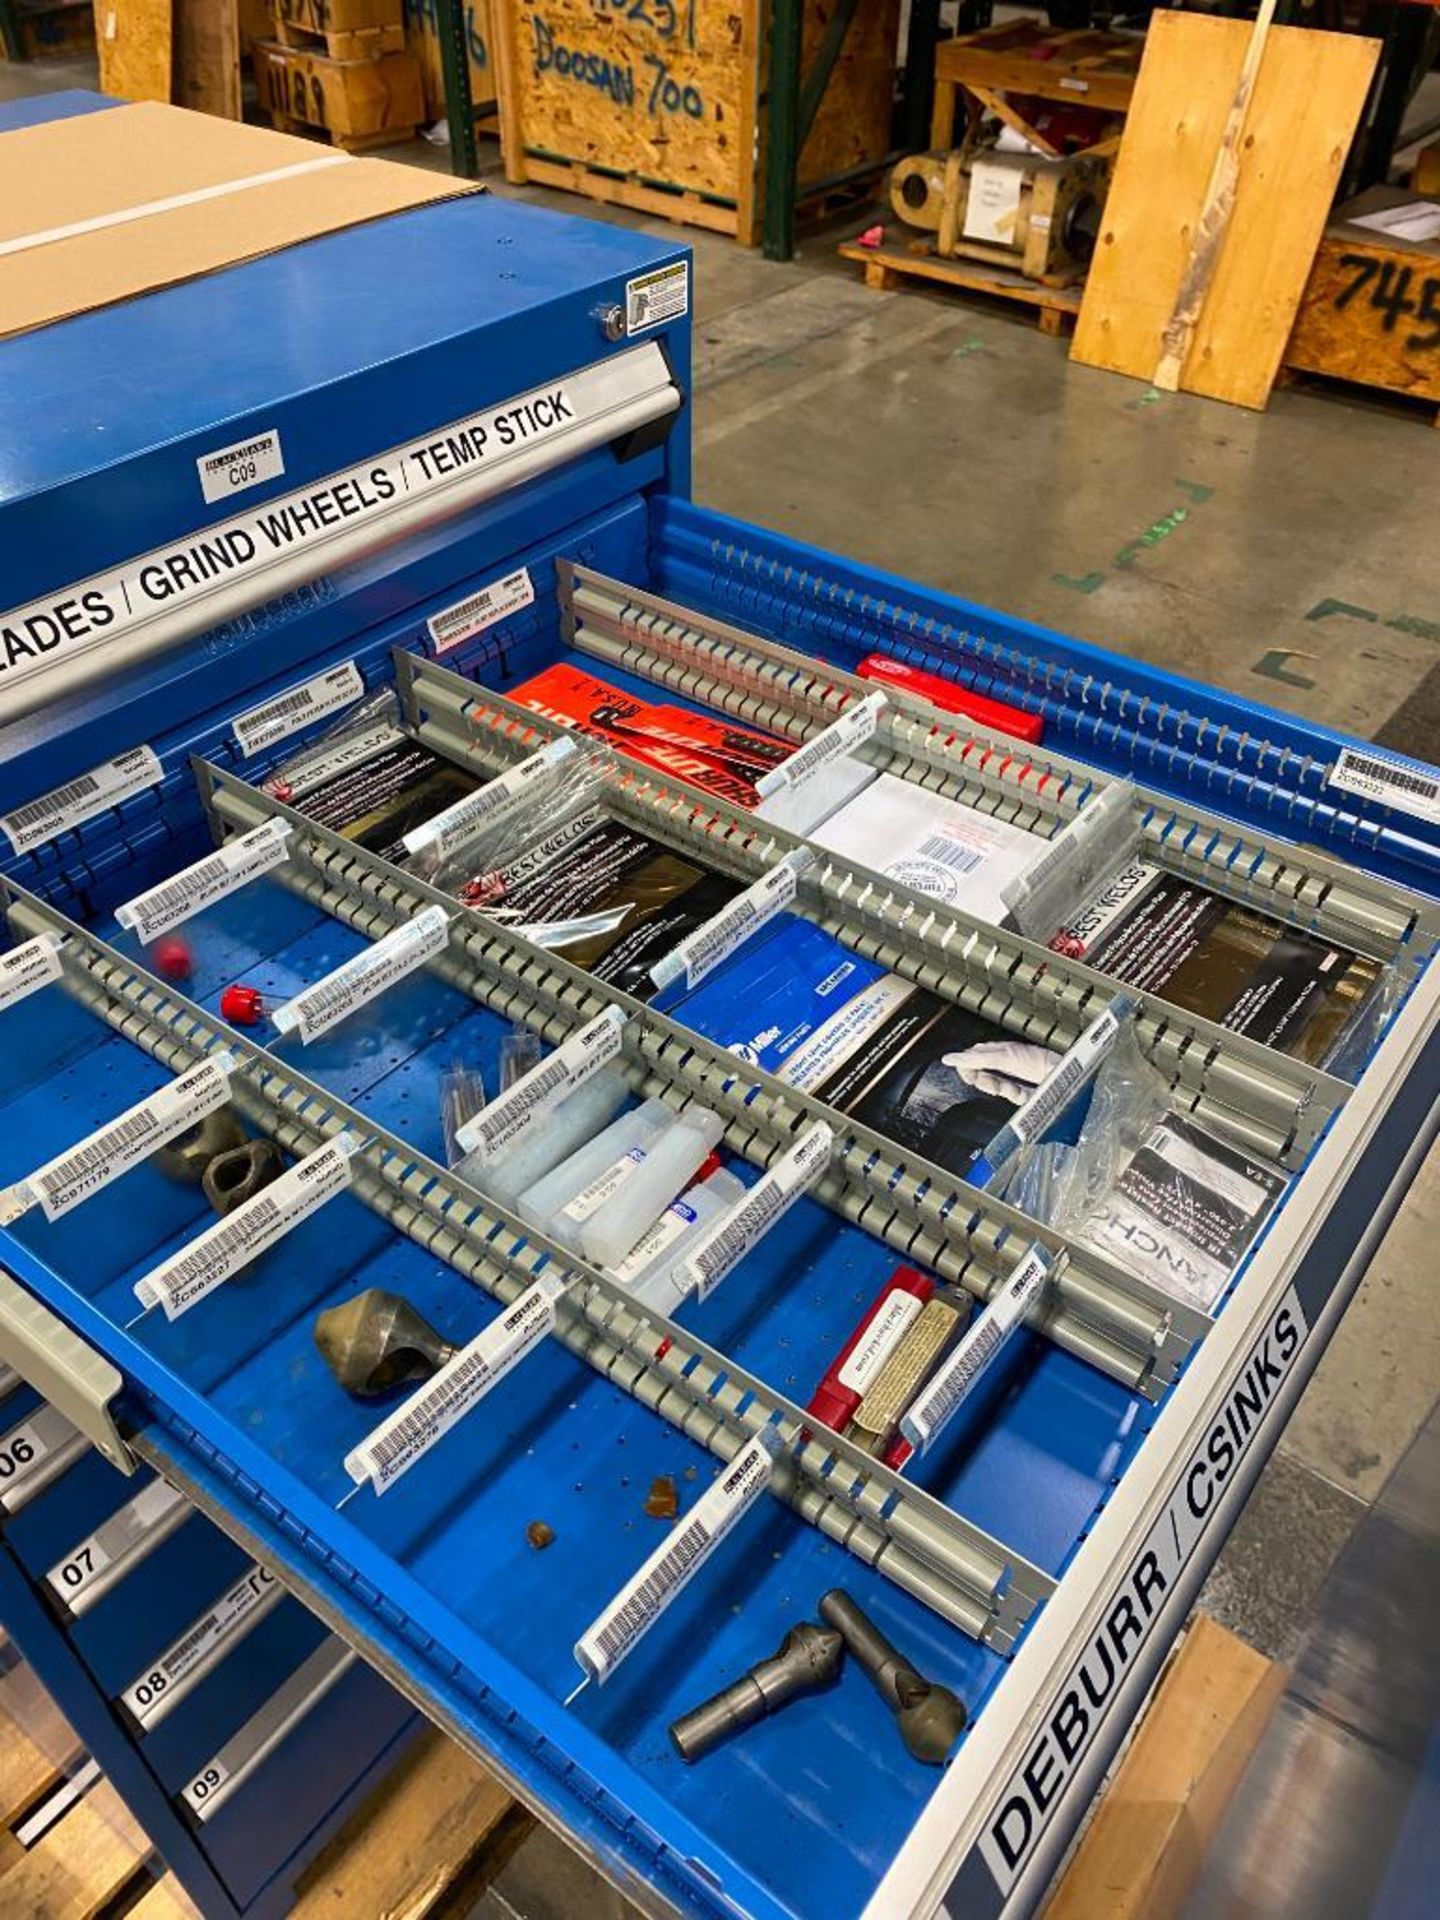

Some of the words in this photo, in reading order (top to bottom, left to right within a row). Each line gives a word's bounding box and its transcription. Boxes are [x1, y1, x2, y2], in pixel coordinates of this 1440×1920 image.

[643, 53, 704, 119] 700
[229, 461, 257, 486] C09
[139, 526, 257, 600] GRIND
[256, 467, 395, 548] WHEELS
[409, 424, 488, 482] TEMP
[494, 391, 574, 445] STICK
[747, 1022, 782, 1054] Miller
[0, 1437, 35, 1479] 06
[62, 1548, 95, 1587] 07
[991, 1553, 1168, 1870] DEBURR
[1185, 1307, 1303, 1522] CSINKS
[135, 1671, 168, 1706] 08
[192, 1768, 221, 1800] 09
